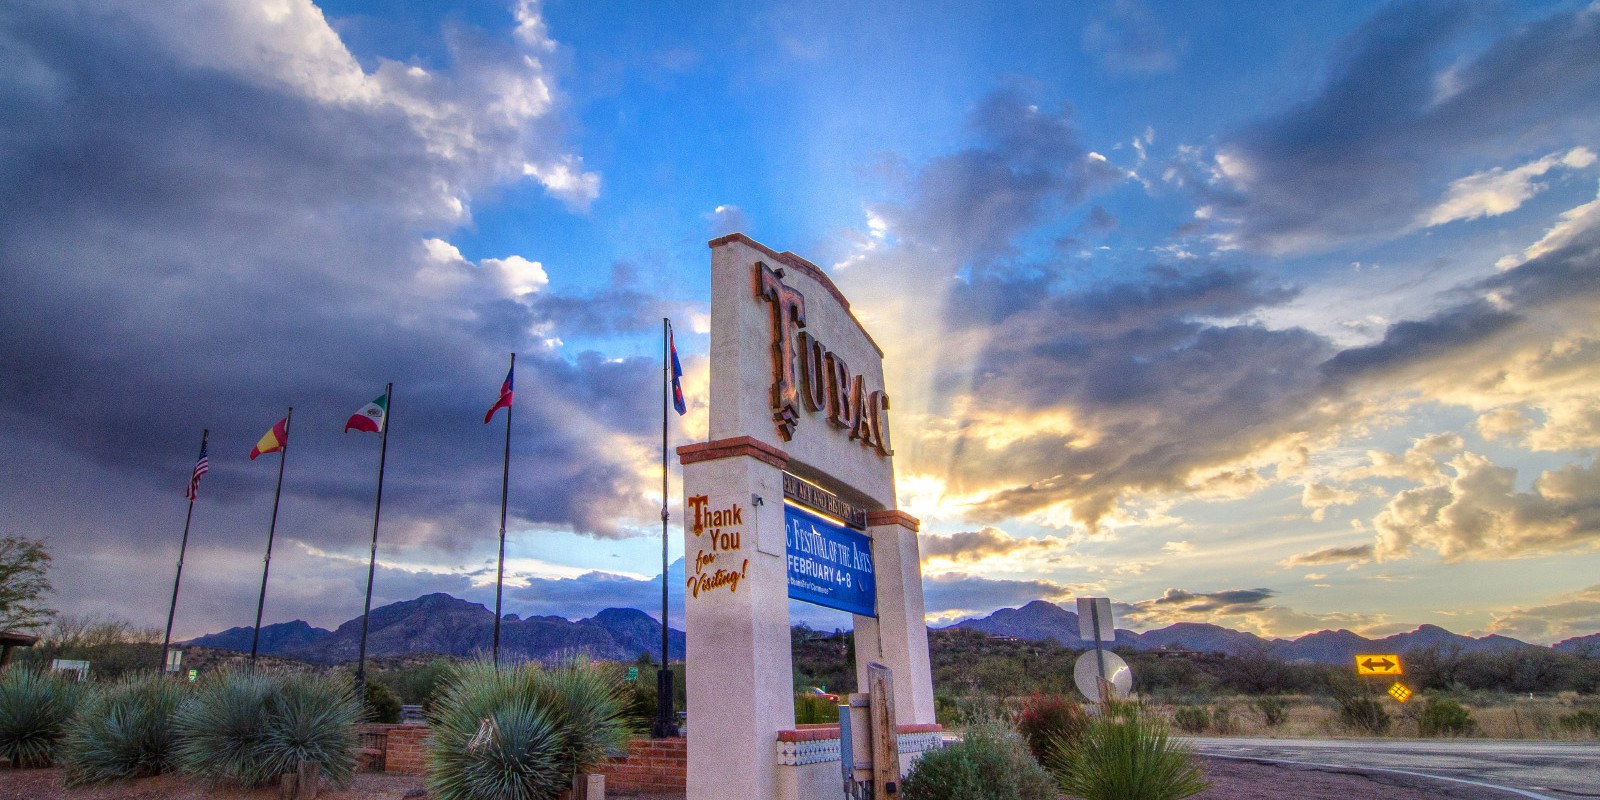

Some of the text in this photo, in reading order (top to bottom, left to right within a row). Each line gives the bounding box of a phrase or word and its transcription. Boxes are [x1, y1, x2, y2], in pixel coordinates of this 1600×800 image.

[754, 261, 894, 456] TUBAC
[688, 494, 743, 537] Thank
[813, 490, 826, 508] AND
[710, 529, 741, 551] You
[793, 518, 829, 560] FESTIVAL
[829, 540, 837, 563] OF
[838, 544, 852, 569] THE
[852, 542, 873, 574] ARTS
[687, 559, 748, 599] Visiting!
[695, 550, 716, 575] for
[788, 554, 852, 588] FEBRUARY 4-8
